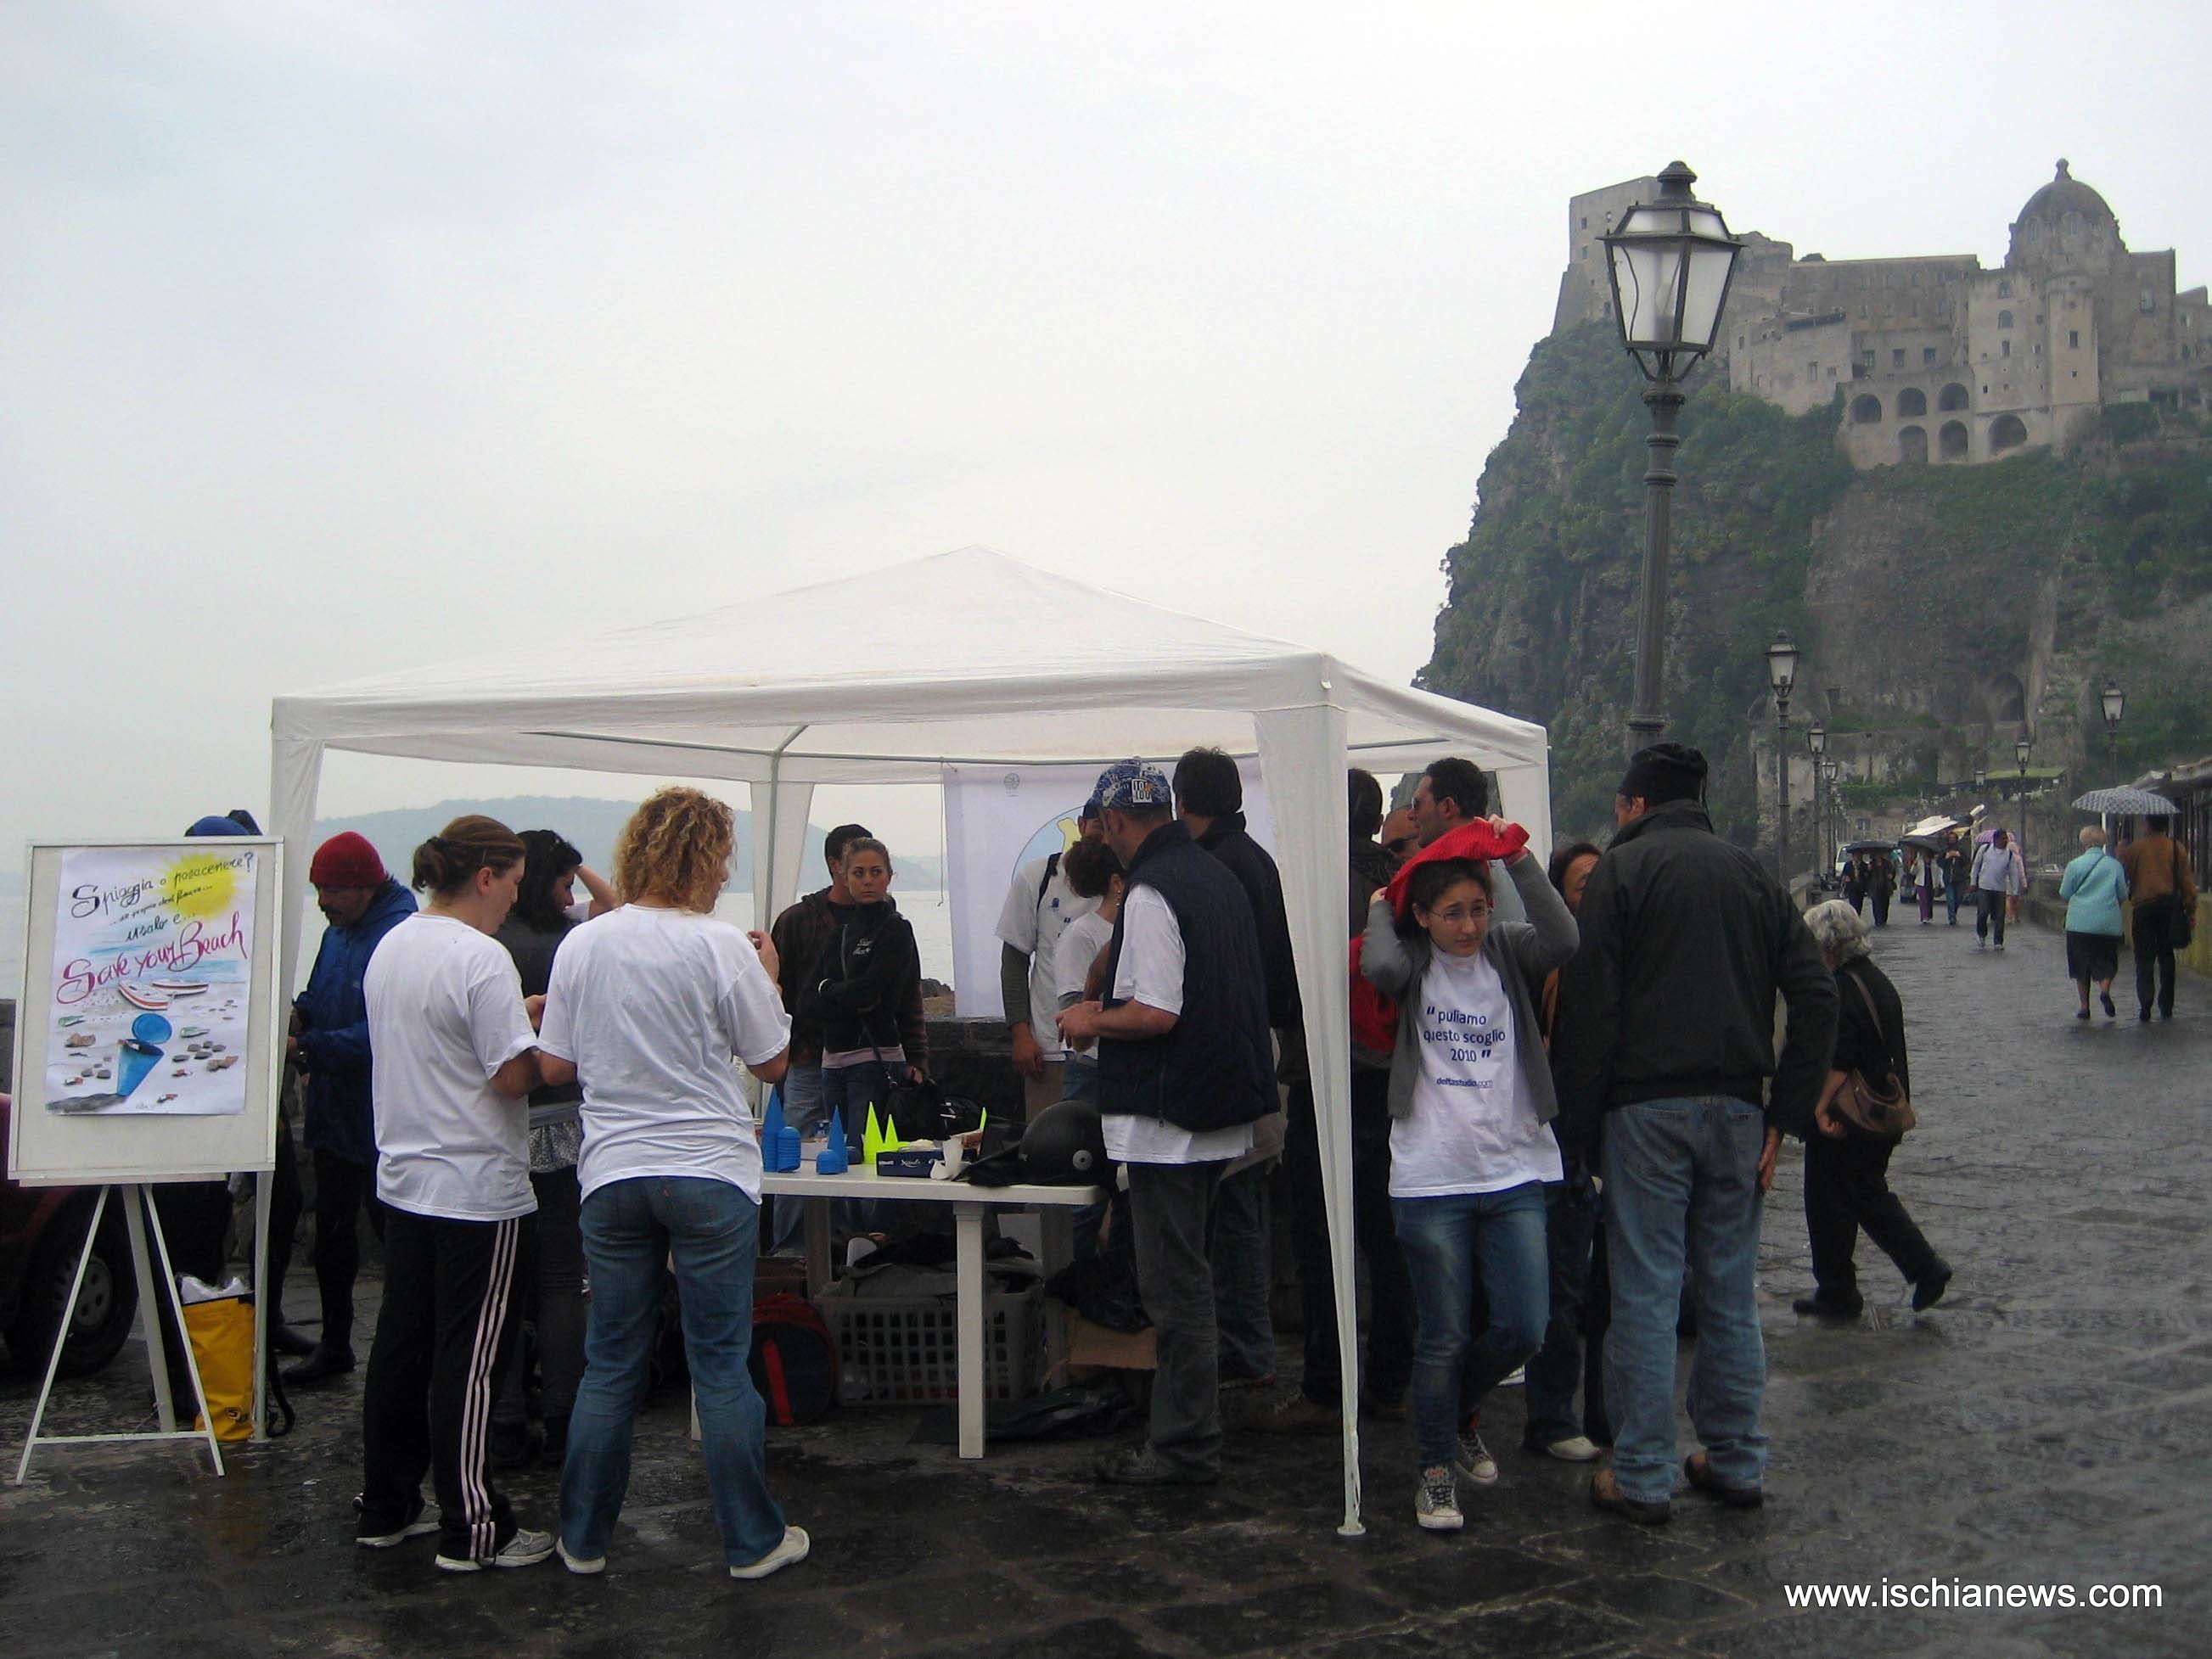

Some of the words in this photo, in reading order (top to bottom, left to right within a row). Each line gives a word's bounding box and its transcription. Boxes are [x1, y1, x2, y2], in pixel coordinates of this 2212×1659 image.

[70, 878, 154, 918] Spiaggia
[125, 916, 168, 943] usalo
[56, 952, 131, 1004] Save
[135, 942, 175, 978] your
[167, 911, 249, 972] Beach
[1463, 1028, 1506, 1046] scoglio
